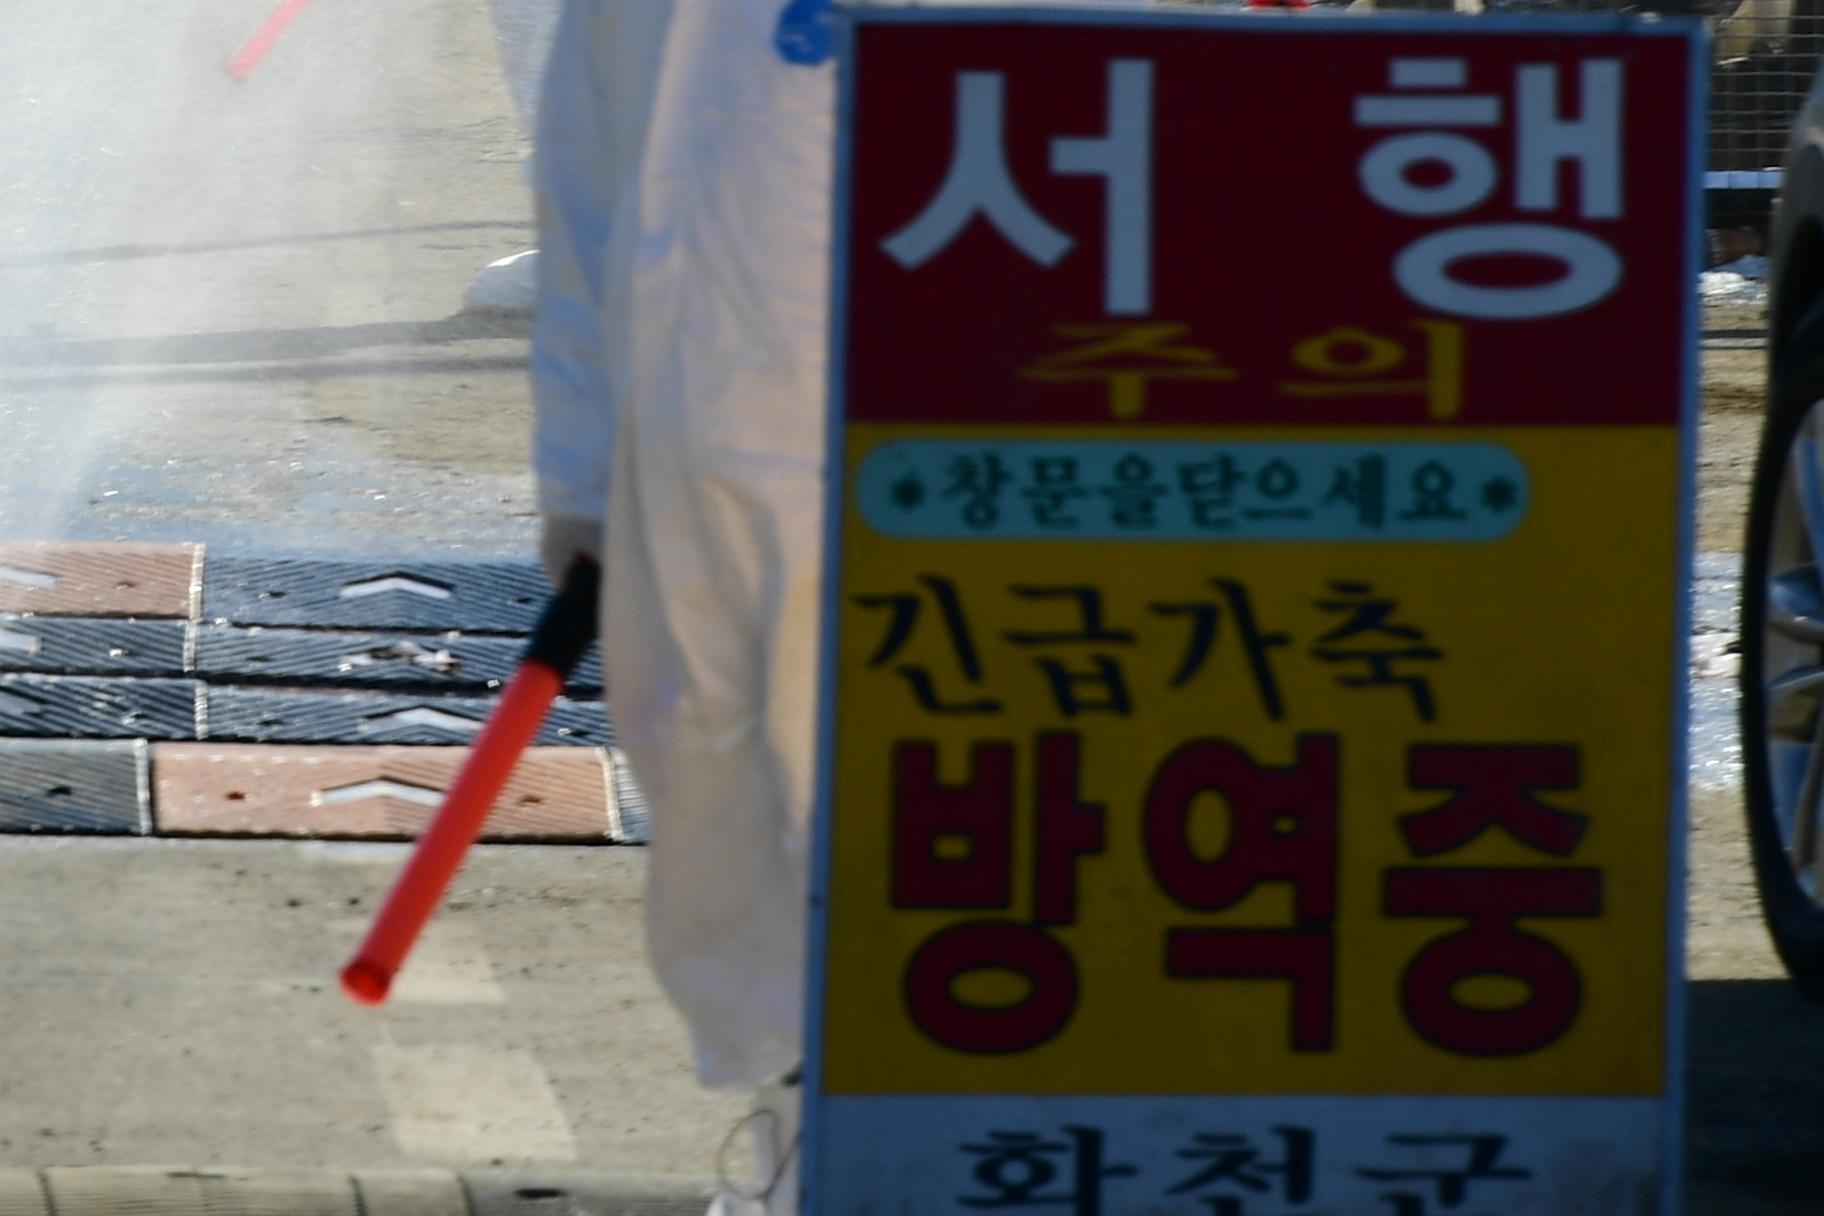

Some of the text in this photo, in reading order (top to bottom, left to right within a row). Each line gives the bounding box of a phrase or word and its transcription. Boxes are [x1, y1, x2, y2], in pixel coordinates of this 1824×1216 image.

[879, 57, 1622, 319] 서행
[1016, 320, 1464, 418] 주의
[889, 730, 1604, 1057] 방역중
[956, 1124, 1534, 1216] 화천군
